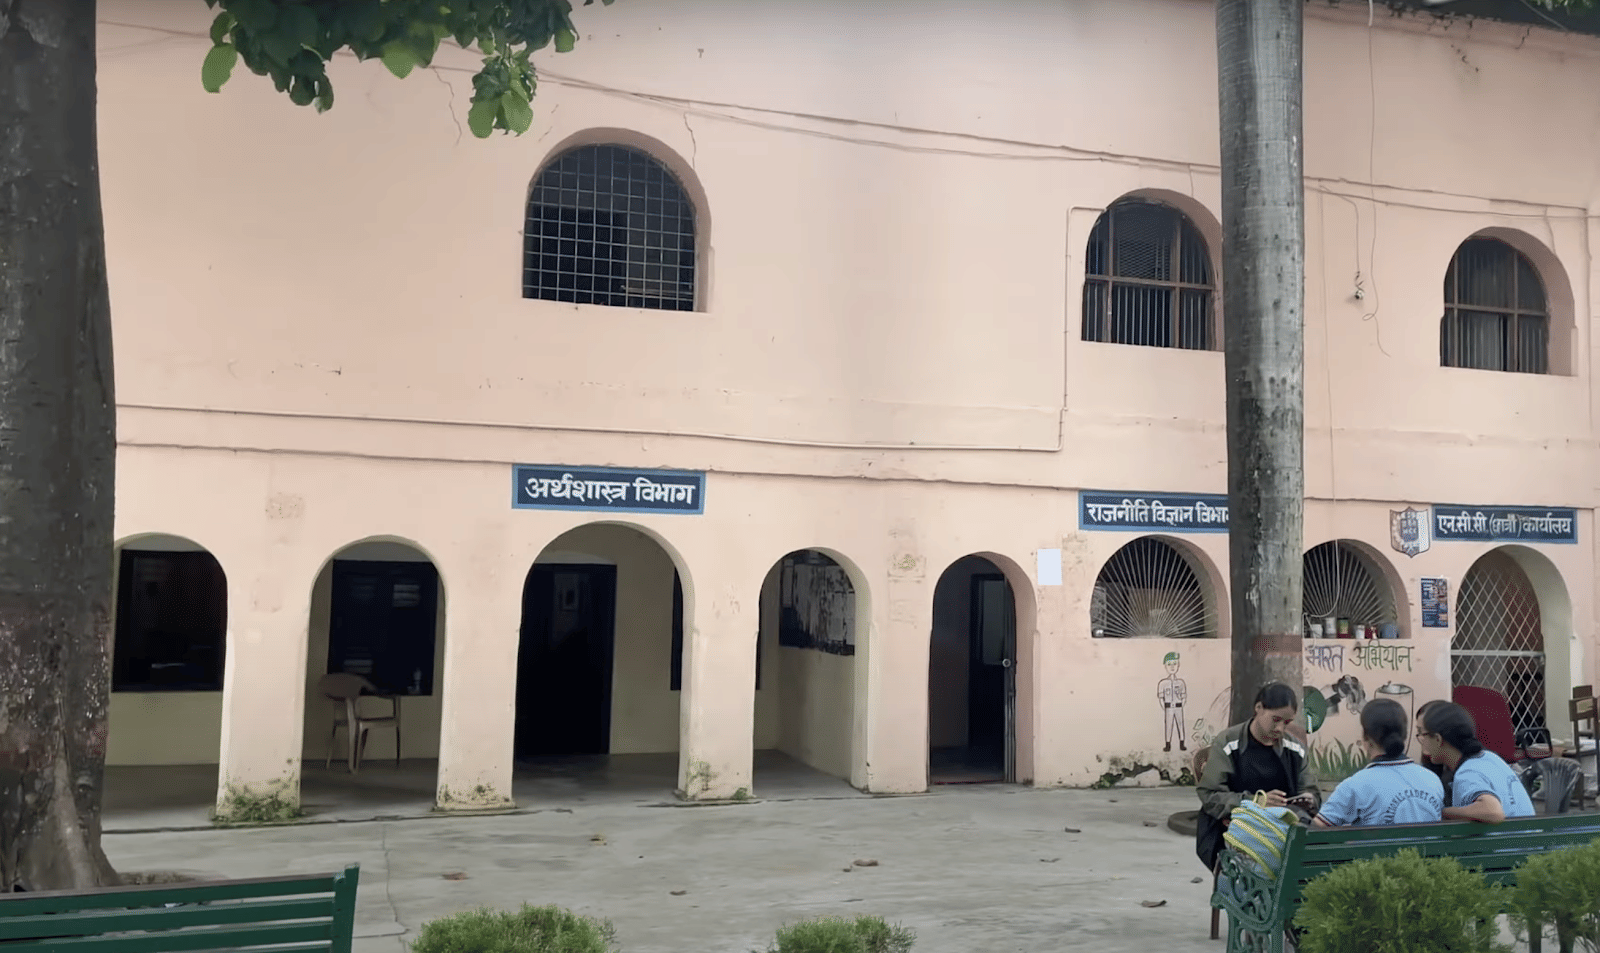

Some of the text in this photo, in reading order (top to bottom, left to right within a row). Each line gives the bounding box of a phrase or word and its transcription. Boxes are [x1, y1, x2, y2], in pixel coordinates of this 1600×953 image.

[525, 473, 696, 505] अर्थशास्त्र विभाग
[1086, 499, 1149, 522] राजनीति
[1151, 500, 1194, 526] विज्ञान
[1522, 512, 1572, 534] कार्यालय
[1305, 638, 1415, 673] भारत अभियान
[1404, 789, 1429, 801] CADET
